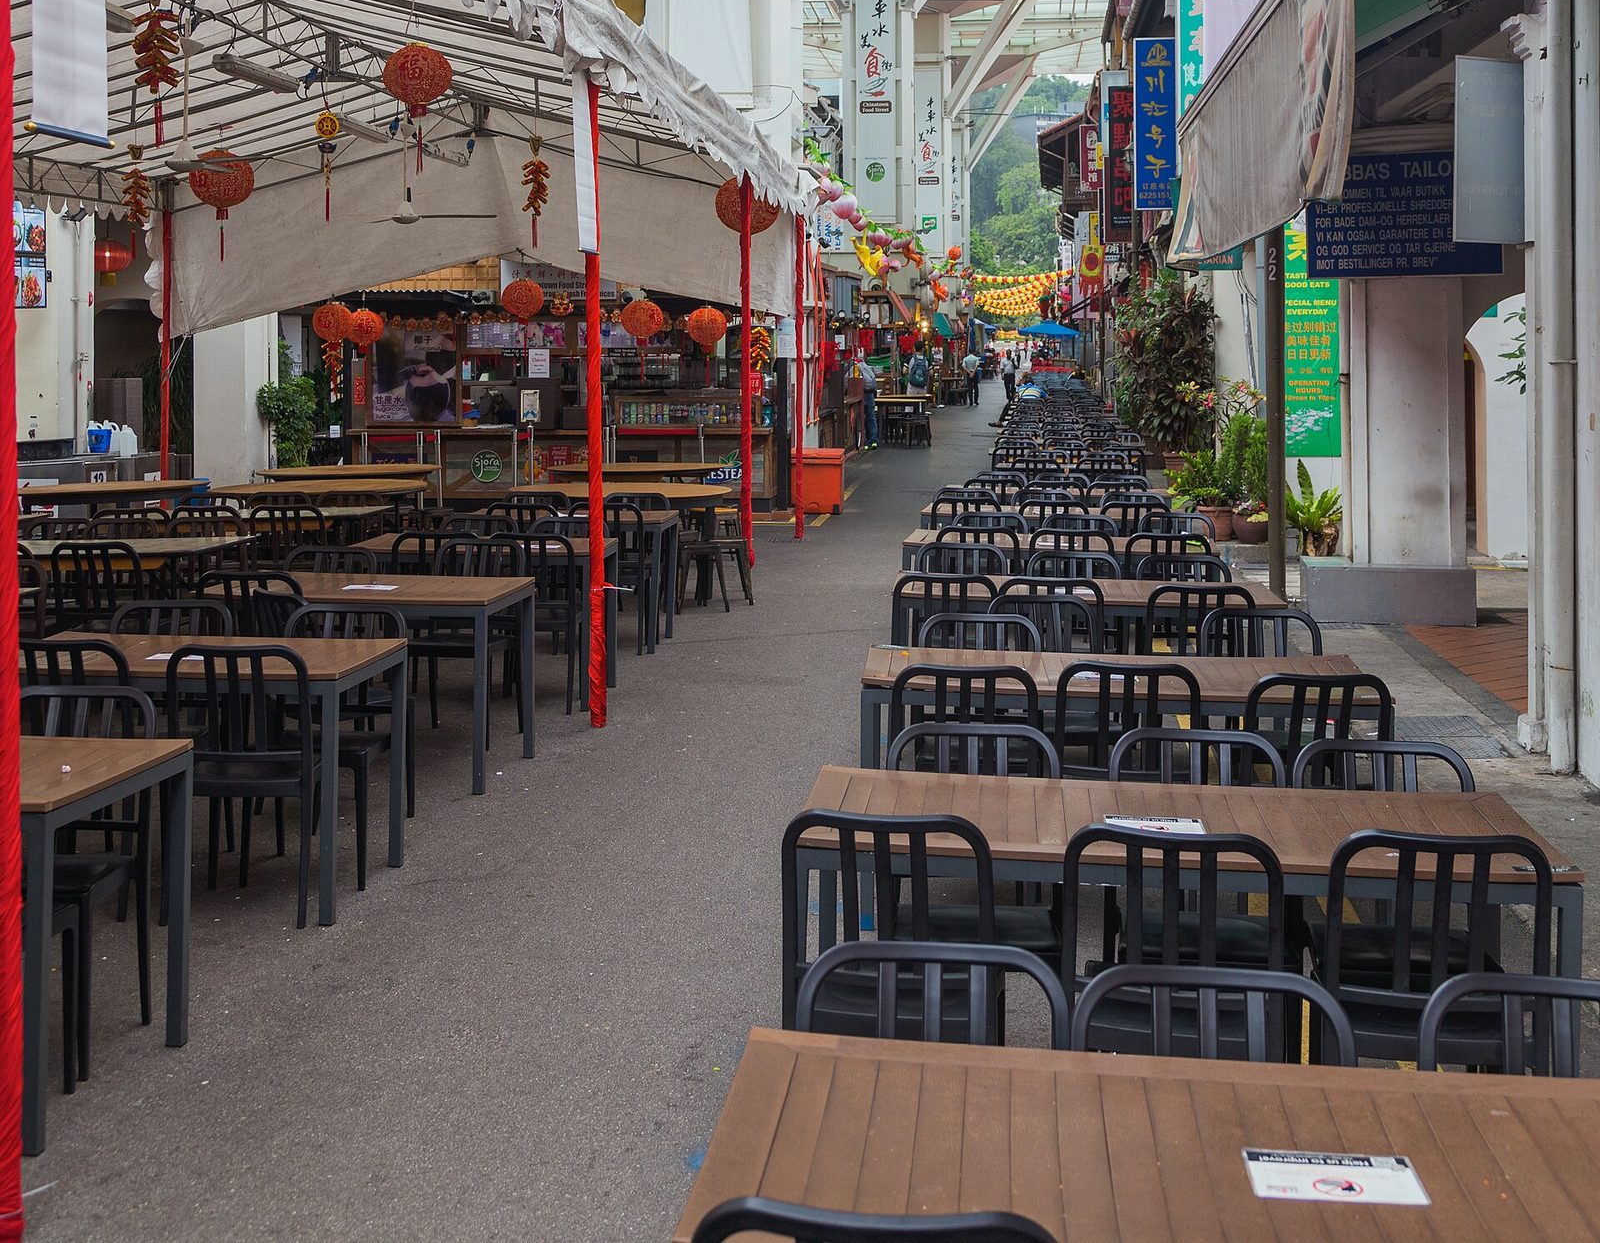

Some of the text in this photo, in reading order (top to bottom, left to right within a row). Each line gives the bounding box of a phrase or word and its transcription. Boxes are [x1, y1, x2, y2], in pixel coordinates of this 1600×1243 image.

[1344, 160, 1452, 182] BBA'S TAILO
[1343, 185, 1445, 200] OMMEN TIL VAAR BUTIKK
[1341, 200, 1407, 214] PROFESJONELLE
[1315, 213, 1451, 229] FOR BADE DAM-OG HERREKLAER
[1316, 232, 1324, 243] VI
[1327, 231, 1344, 242] KAN
[1347, 230, 1376, 241] OGSAA
[1379, 228, 1429, 240] GARANTERE
[1432, 228, 1444, 239] EN
[1316, 241, 1456, 257] OG GOD SERVICE OG TAR GJERNE
[1316, 259, 1335, 270] IMOT
[1338, 257, 1393, 269] BESTILLINGER
[1396, 257, 1409, 268] PR.
[474, 455, 500, 477] sjora
[707, 468, 742, 479] ESTEA
[1326, 1158, 1340, 1166] us
[1341, 1158, 1369, 1167] Help
